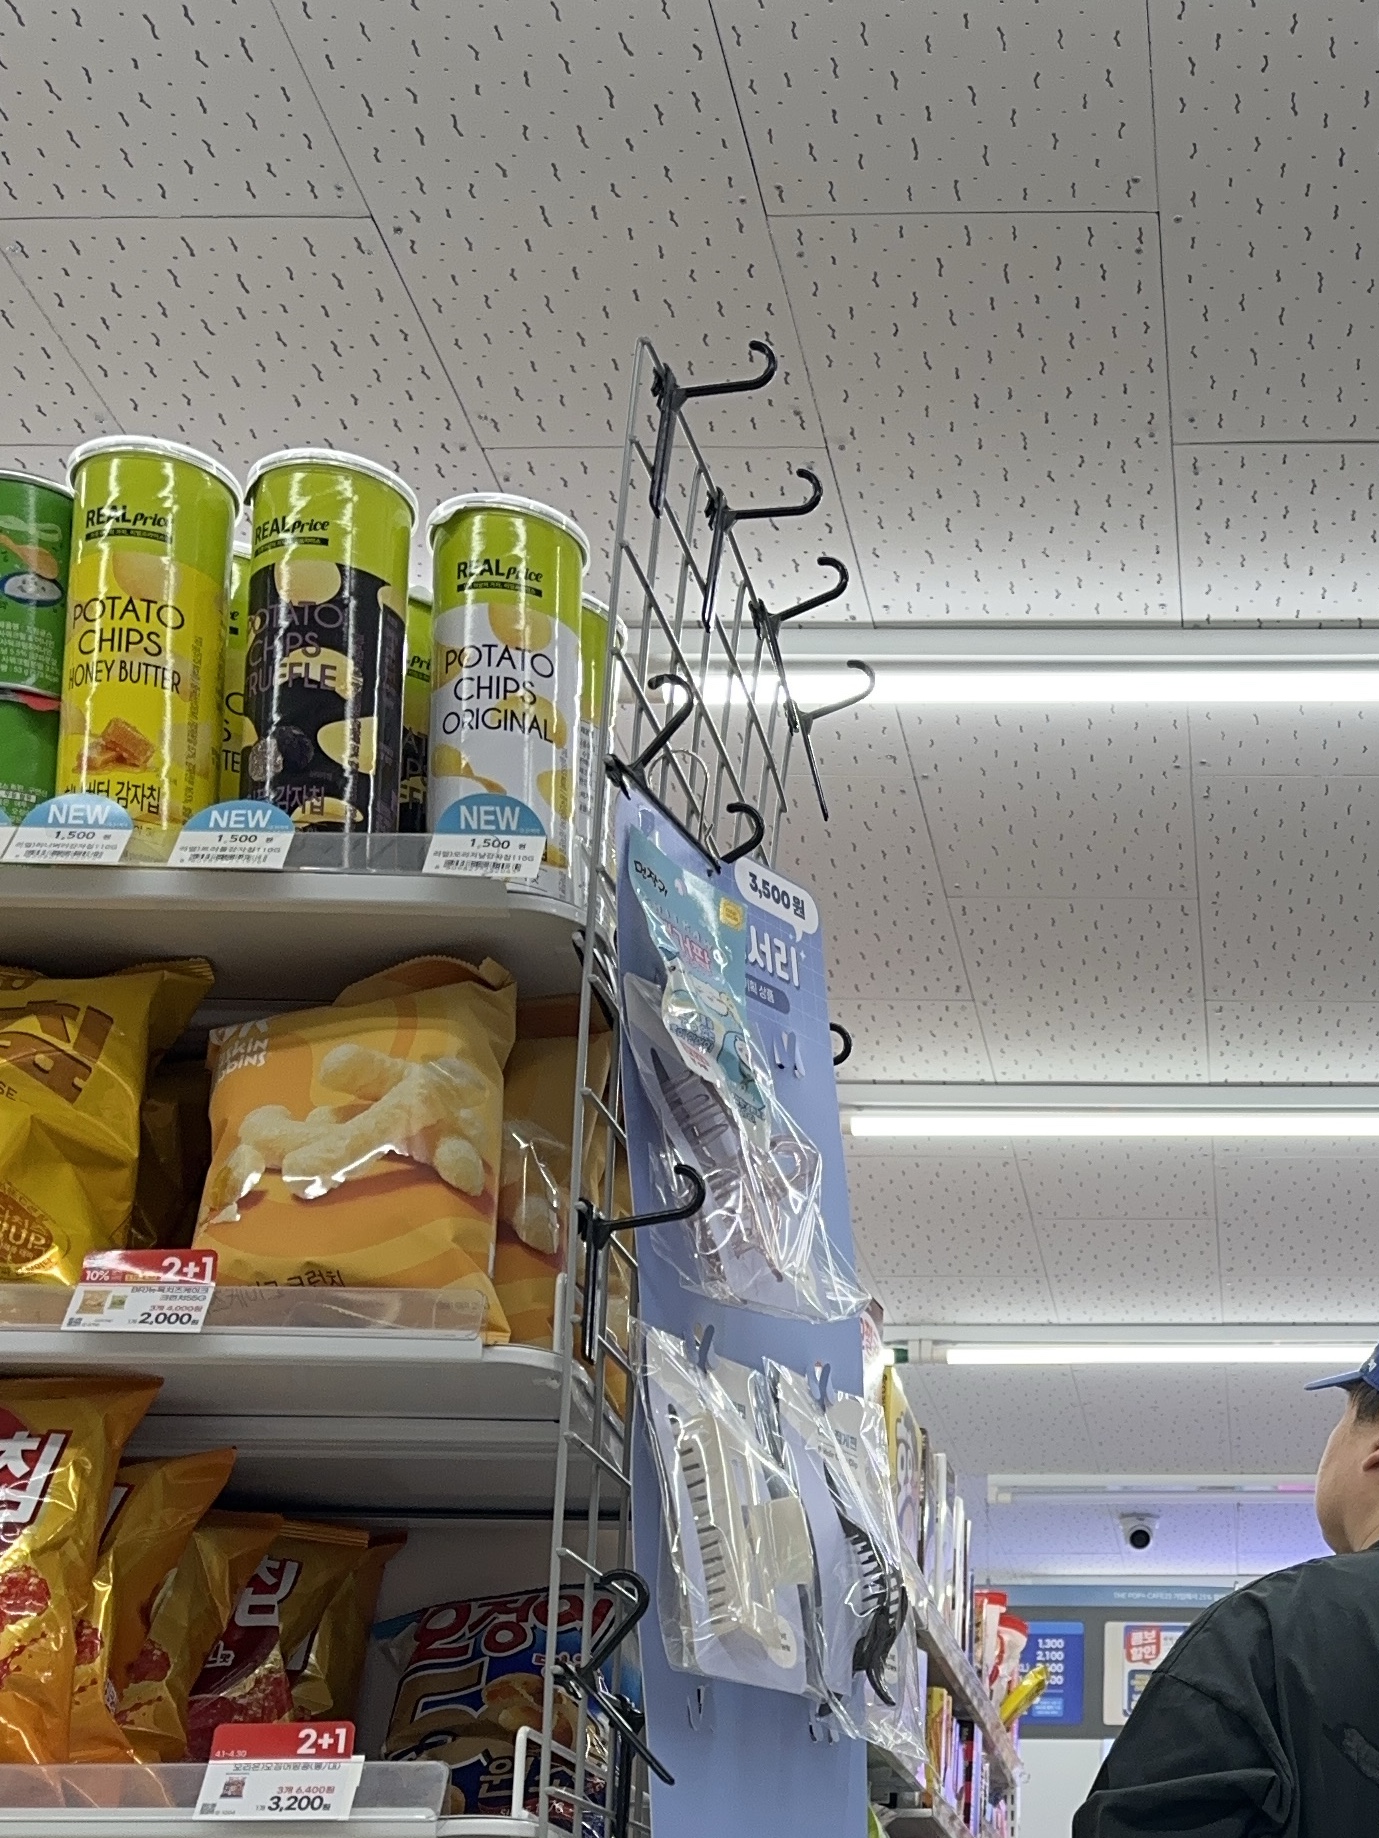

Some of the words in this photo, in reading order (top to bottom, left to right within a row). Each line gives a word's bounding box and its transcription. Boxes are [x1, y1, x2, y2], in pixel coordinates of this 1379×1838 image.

[86, 505, 131, 529] REAL
[291, 517, 330, 535] Price
[457, 558, 505, 580] REAL
[73, 596, 185, 630] POTATO
[78, 627, 162, 657] CHIPS
[445, 643, 555, 679] POTATO
[69, 660, 115, 690] HONEY
[118, 660, 181, 695] BUTTER
[453, 675, 537, 707] CHIPS
[442, 706, 554, 744] ORIGINAL
[48, 804, 111, 825] NEW
[209, 809, 272, 828] NEW
[459, 805, 520, 831] NEW
[54, 830, 96, 840] 1,500
[217, 834, 258, 843] 1,500
[470, 838, 511, 850] 1,500
[748, 871, 791, 910] 3,500
[792, 895, 806, 921] 원
[746, 924, 800, 988] 서리
[85, 1271, 111, 1282] 10%
[162, 1256, 215, 1283] 2+1
[296, 1727, 348, 1755] 2+1
